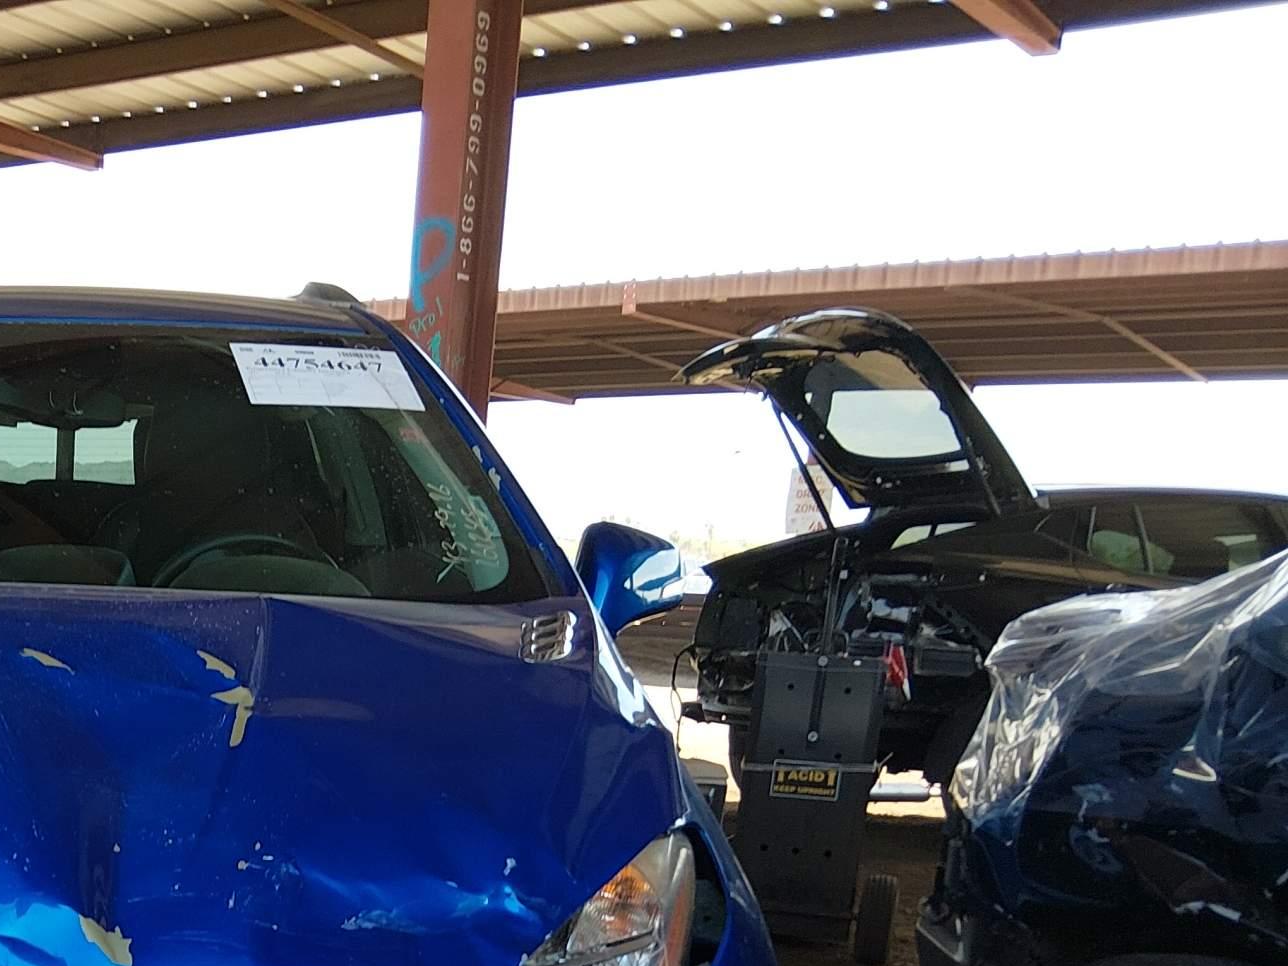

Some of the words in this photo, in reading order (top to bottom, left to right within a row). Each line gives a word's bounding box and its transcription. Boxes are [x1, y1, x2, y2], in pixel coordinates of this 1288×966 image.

[456, 10, 491, 282] 1-866-799-0969
[254, 356, 382, 374] 44754647
[787, 769, 825, 783] ACID
